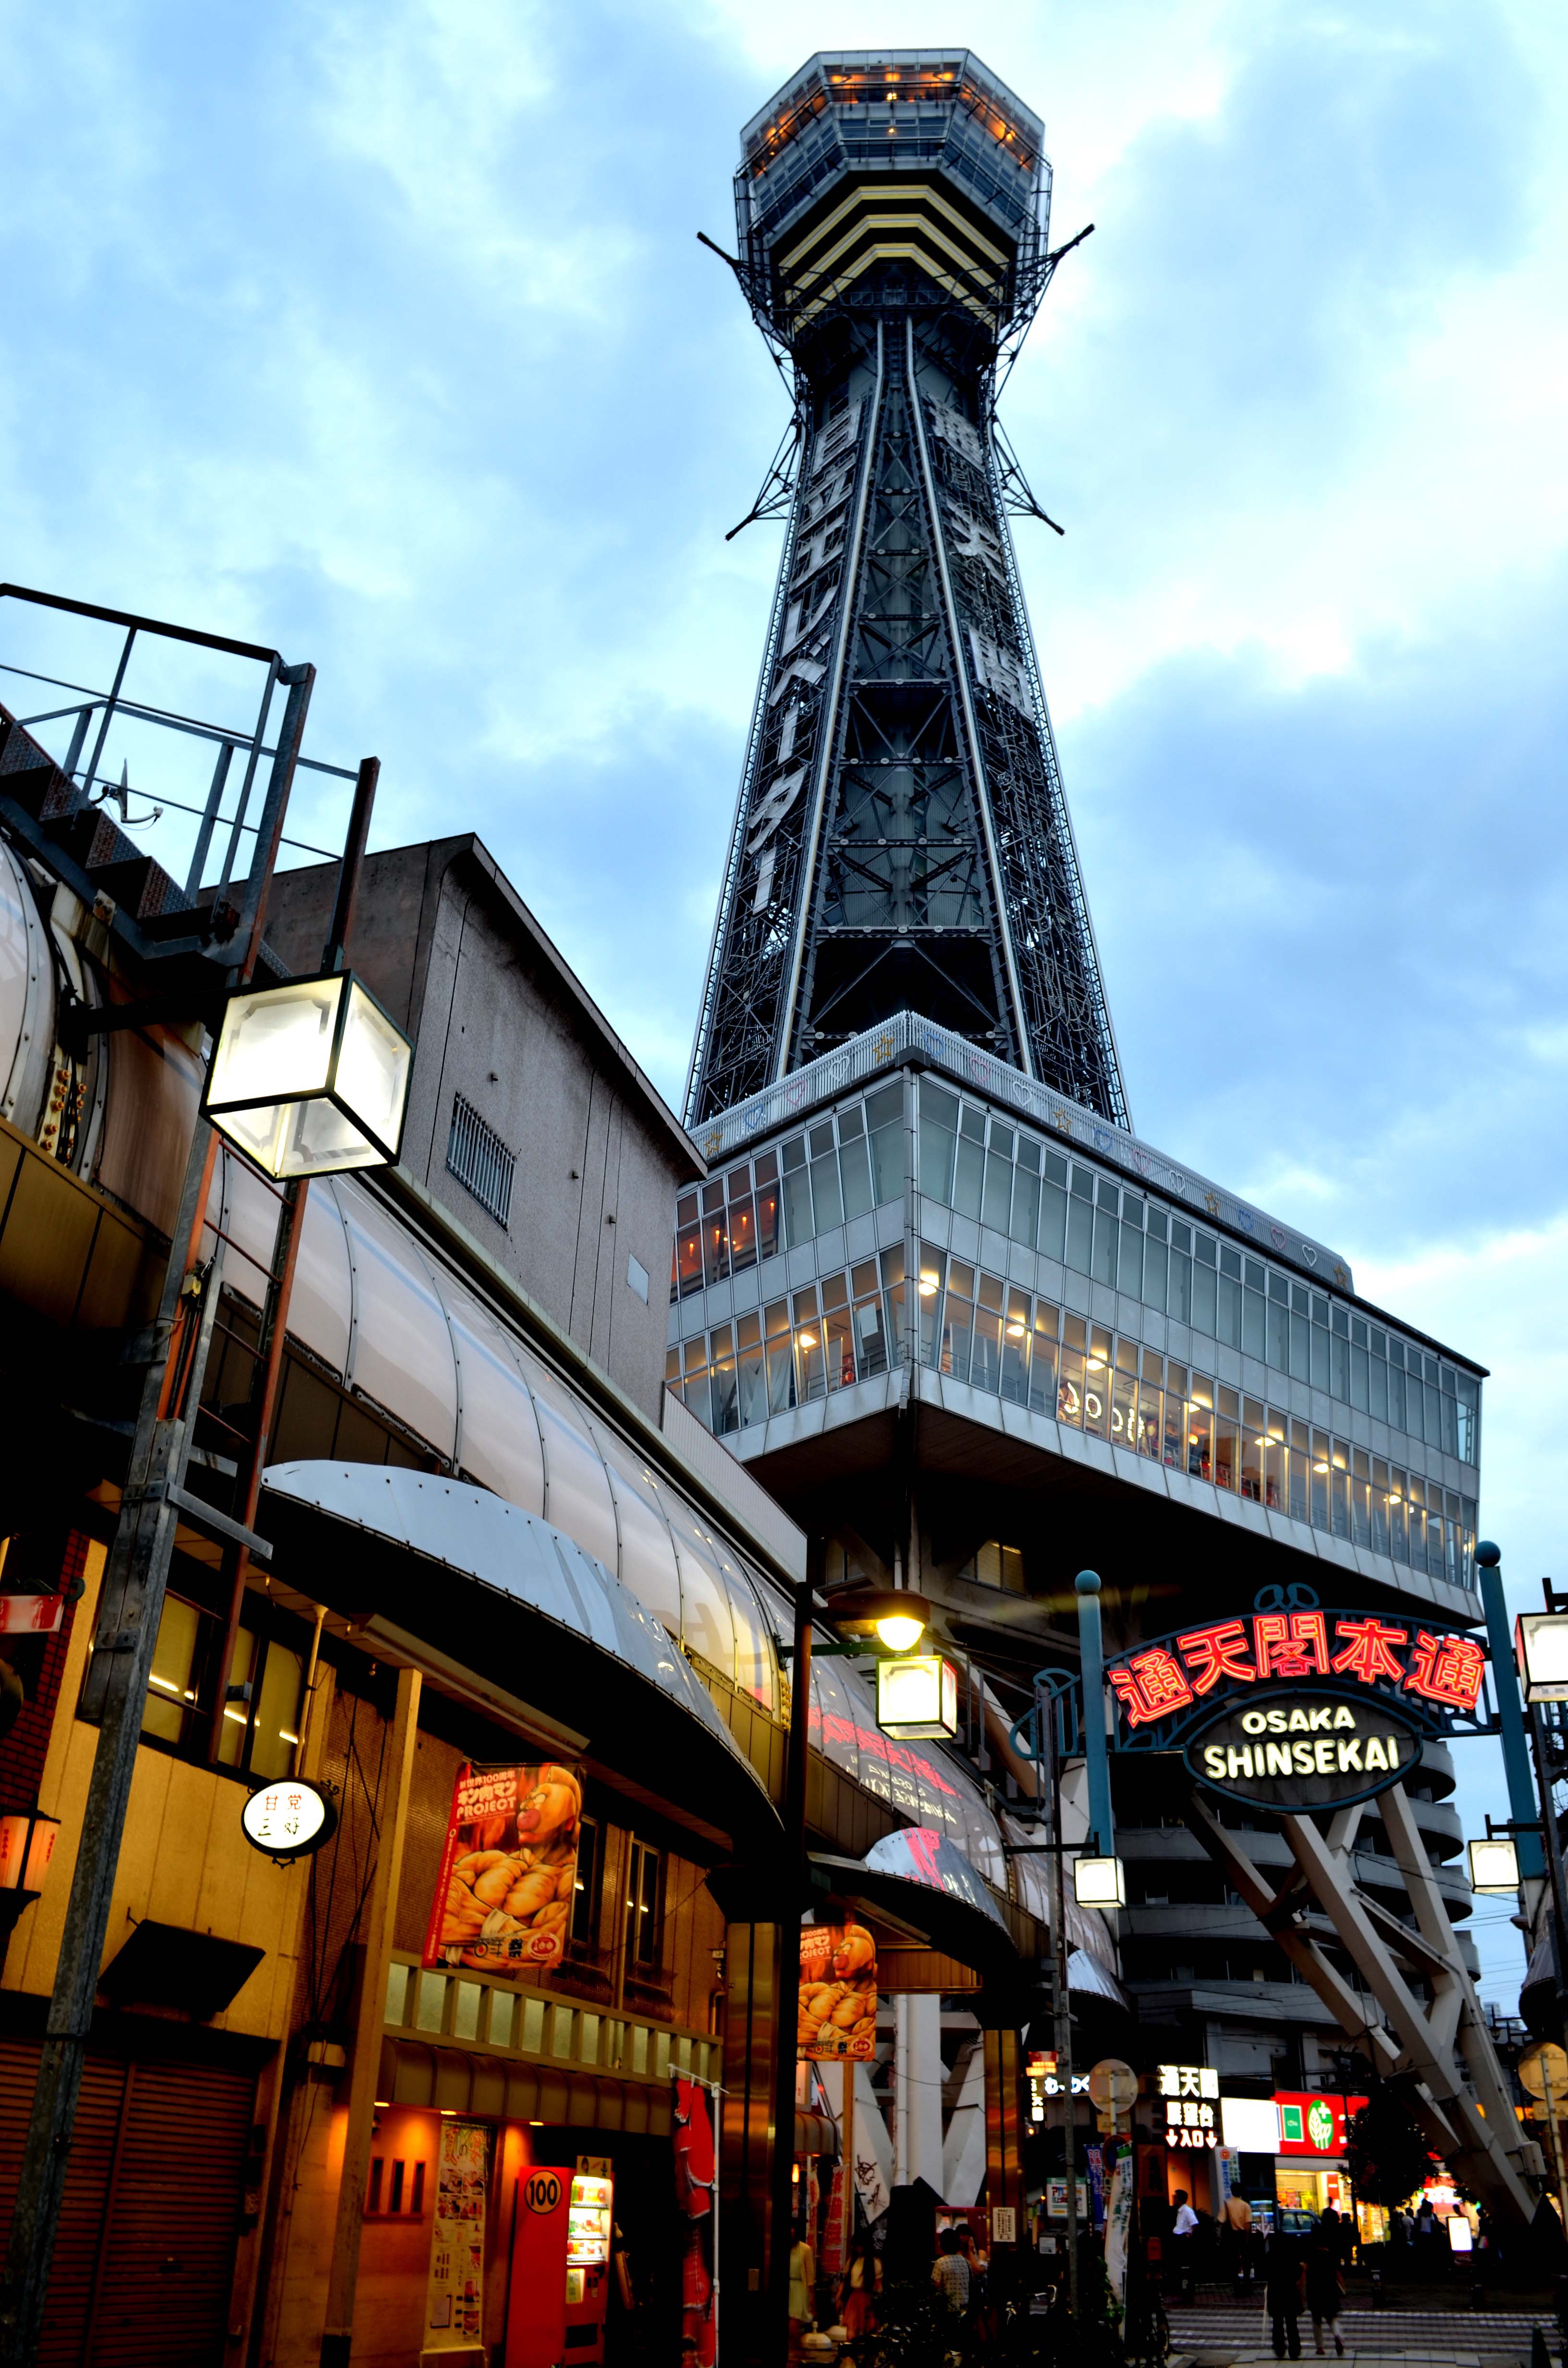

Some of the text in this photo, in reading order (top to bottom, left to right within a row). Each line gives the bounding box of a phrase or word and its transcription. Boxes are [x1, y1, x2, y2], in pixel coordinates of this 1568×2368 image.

[1107, 1611, 1485, 1728] 通天閣本通
[1242, 1706, 1356, 1736] OSAKA
[1204, 1735, 1399, 1779] SHINSEKAI
[456, 1796, 516, 1819] PROJECT
[800, 1945, 831, 1959] OJECT
[1180, 2129, 1204, 2148] 入口
[529, 2179, 558, 2206] 100
